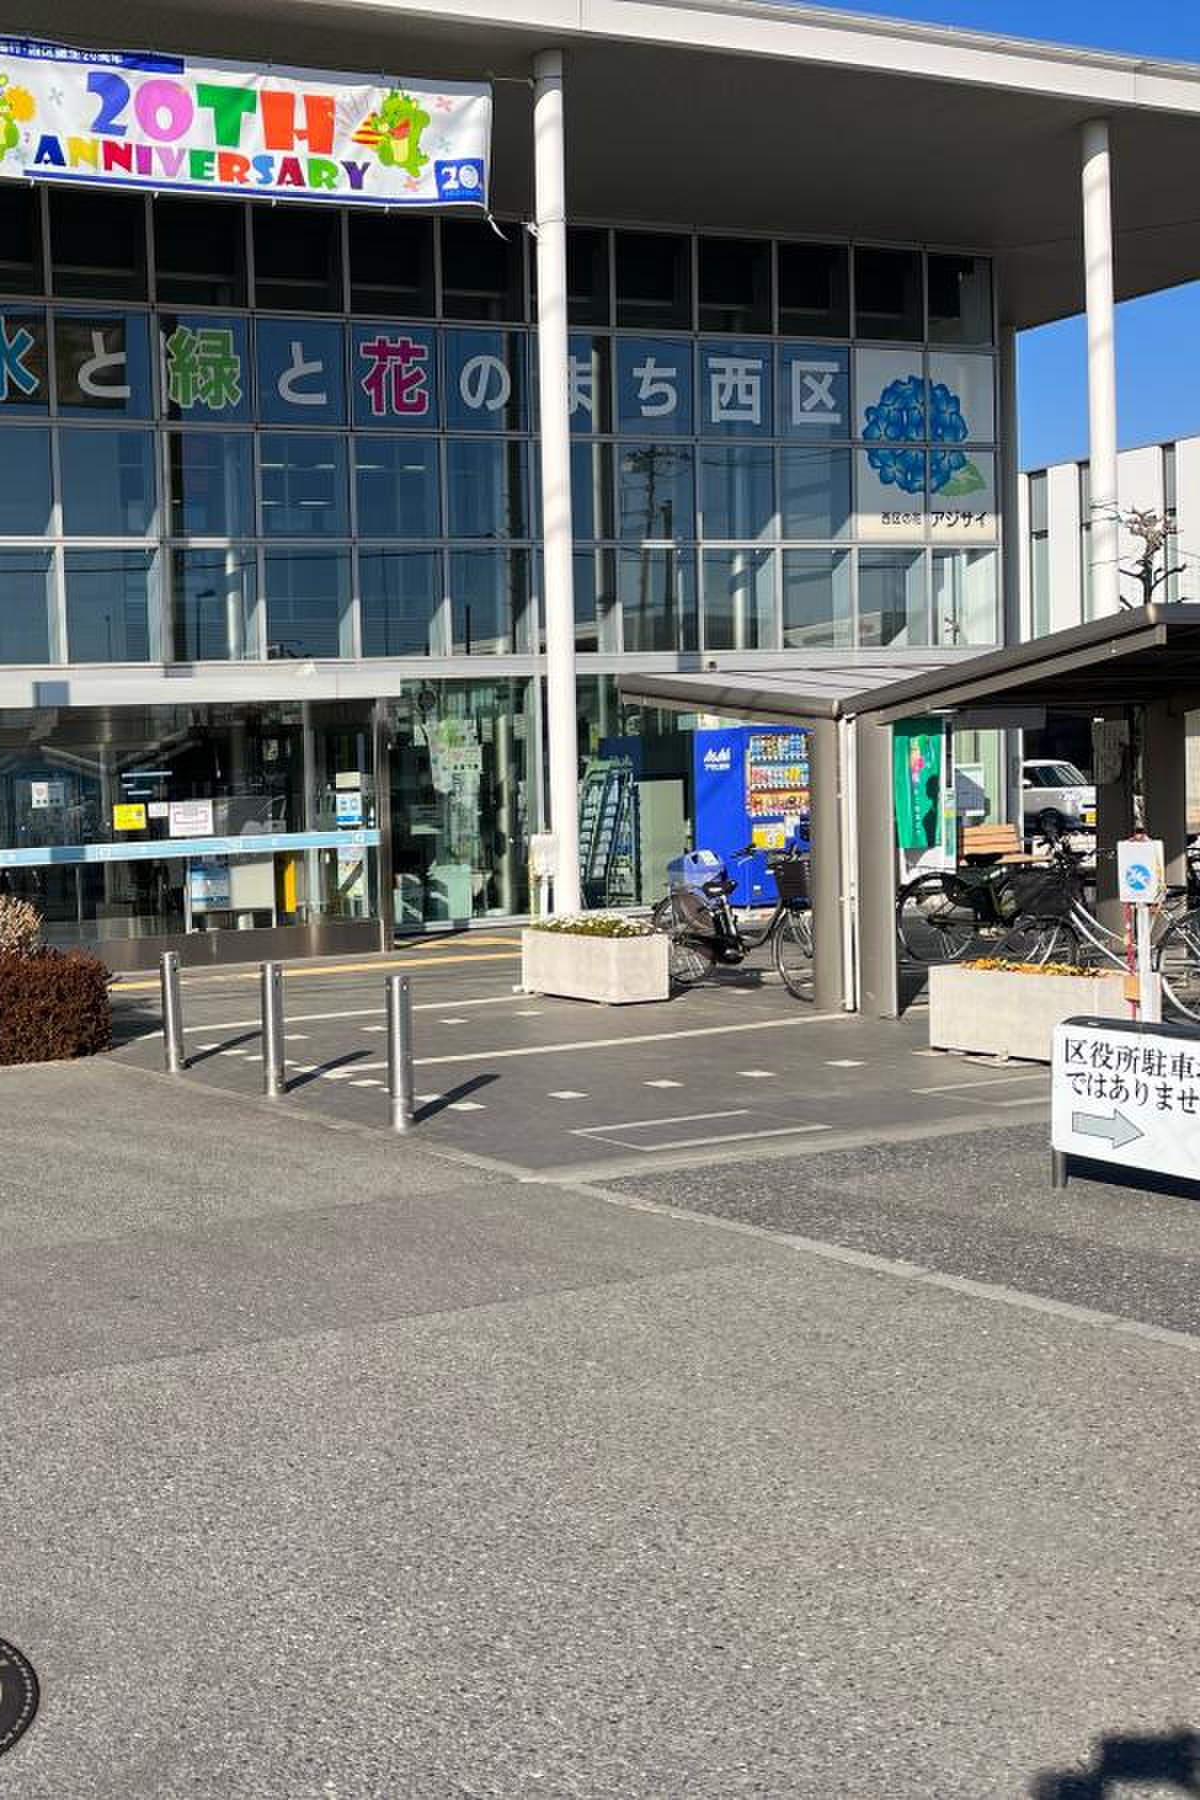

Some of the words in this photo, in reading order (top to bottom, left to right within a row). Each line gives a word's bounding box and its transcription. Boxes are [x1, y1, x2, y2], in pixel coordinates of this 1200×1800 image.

[85, 71, 336, 154] 20TH
[33, 134, 370, 191] ANNIVERSARY
[441, 165, 479, 189] 20
[931, 511, 987, 528] アジサイ
[1065, 1038, 1200, 1082] 区役所駐車
[1066, 1072, 1200, 1115] ではありませ
